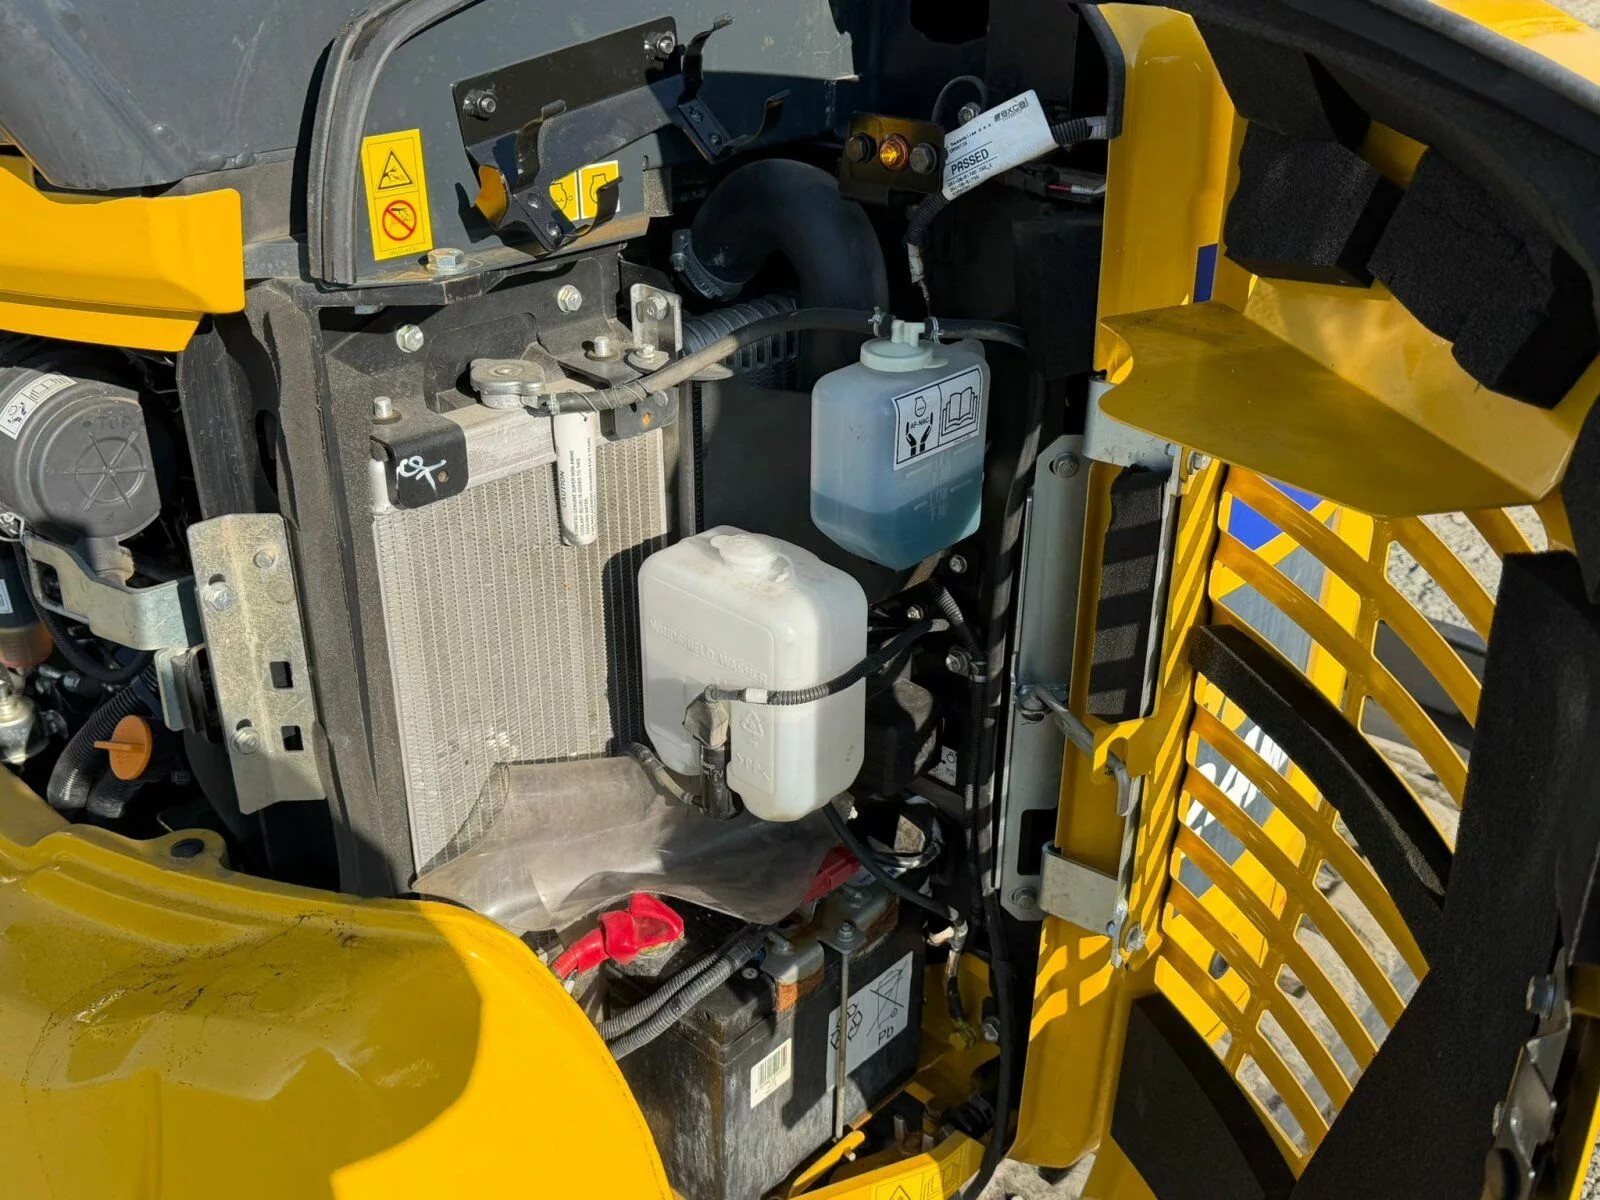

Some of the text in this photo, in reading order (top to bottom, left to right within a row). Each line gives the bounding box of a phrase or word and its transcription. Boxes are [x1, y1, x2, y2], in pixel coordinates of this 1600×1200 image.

[1000, 98, 1029, 118] excel
[951, 148, 989, 176] PASSED
[650, 618, 769, 686] WINDSHIELD WASHER
[877, 1025, 894, 1046] Pb
